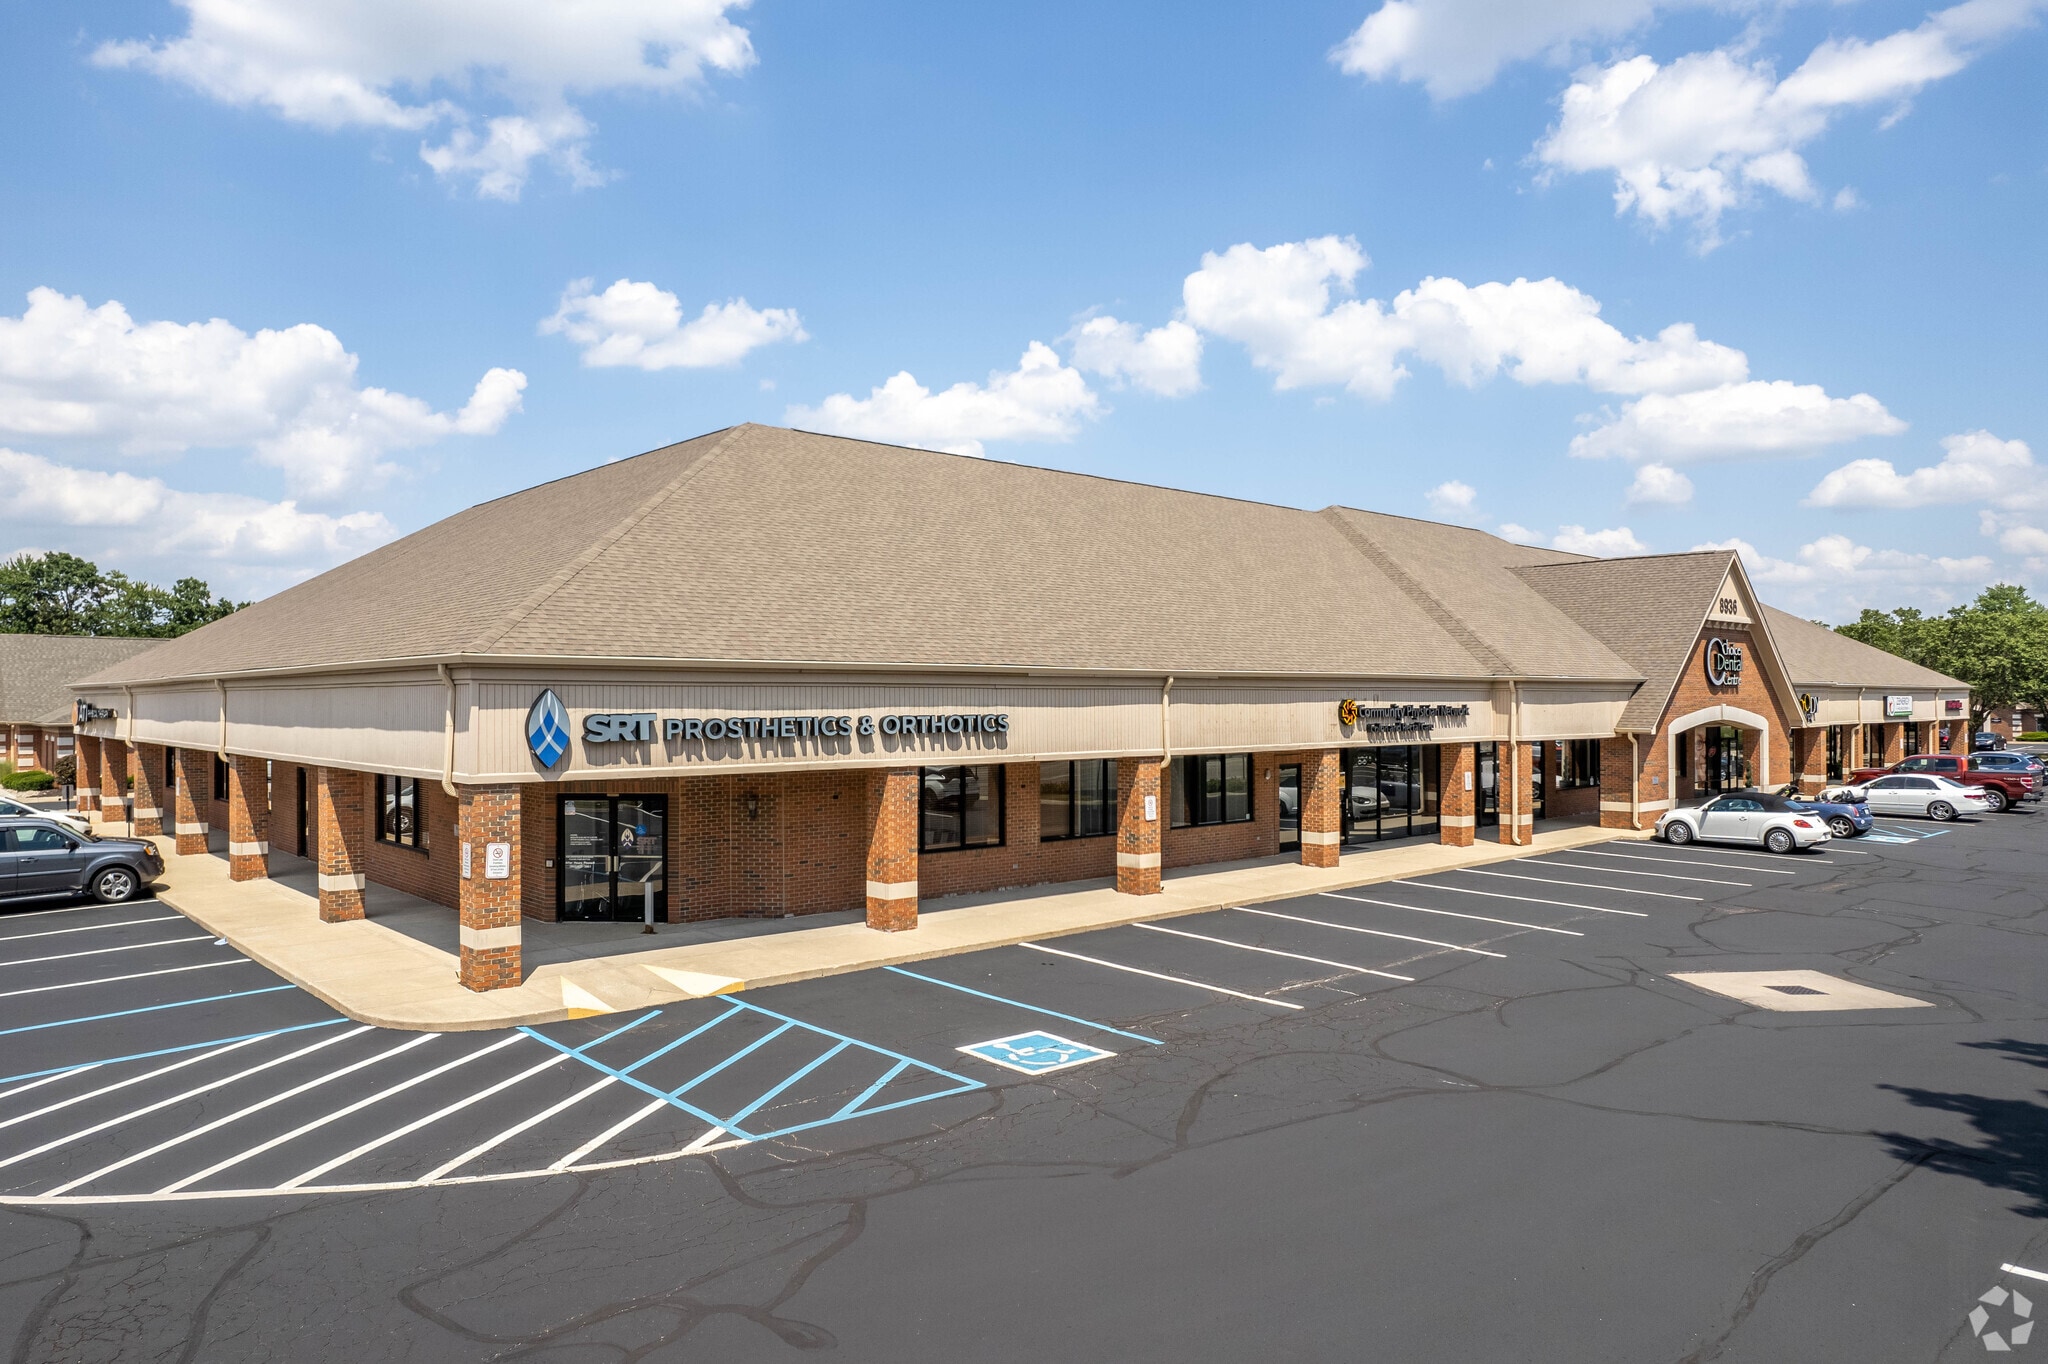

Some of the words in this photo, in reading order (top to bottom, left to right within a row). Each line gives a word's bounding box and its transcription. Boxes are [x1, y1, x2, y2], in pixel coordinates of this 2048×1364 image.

[1720, 598, 1737, 615] 8936
[1717, 653, 1742, 671] Dental
[1359, 705, 1404, 719] Community
[1407, 704, 1439, 719] Physician
[1441, 704, 1469, 716] Network
[584, 713, 657, 743] SRT
[665, 714, 852, 741] PROSTHETICS
[858, 715, 875, 736] &
[881, 713, 1009, 736] ORTHOTICS
